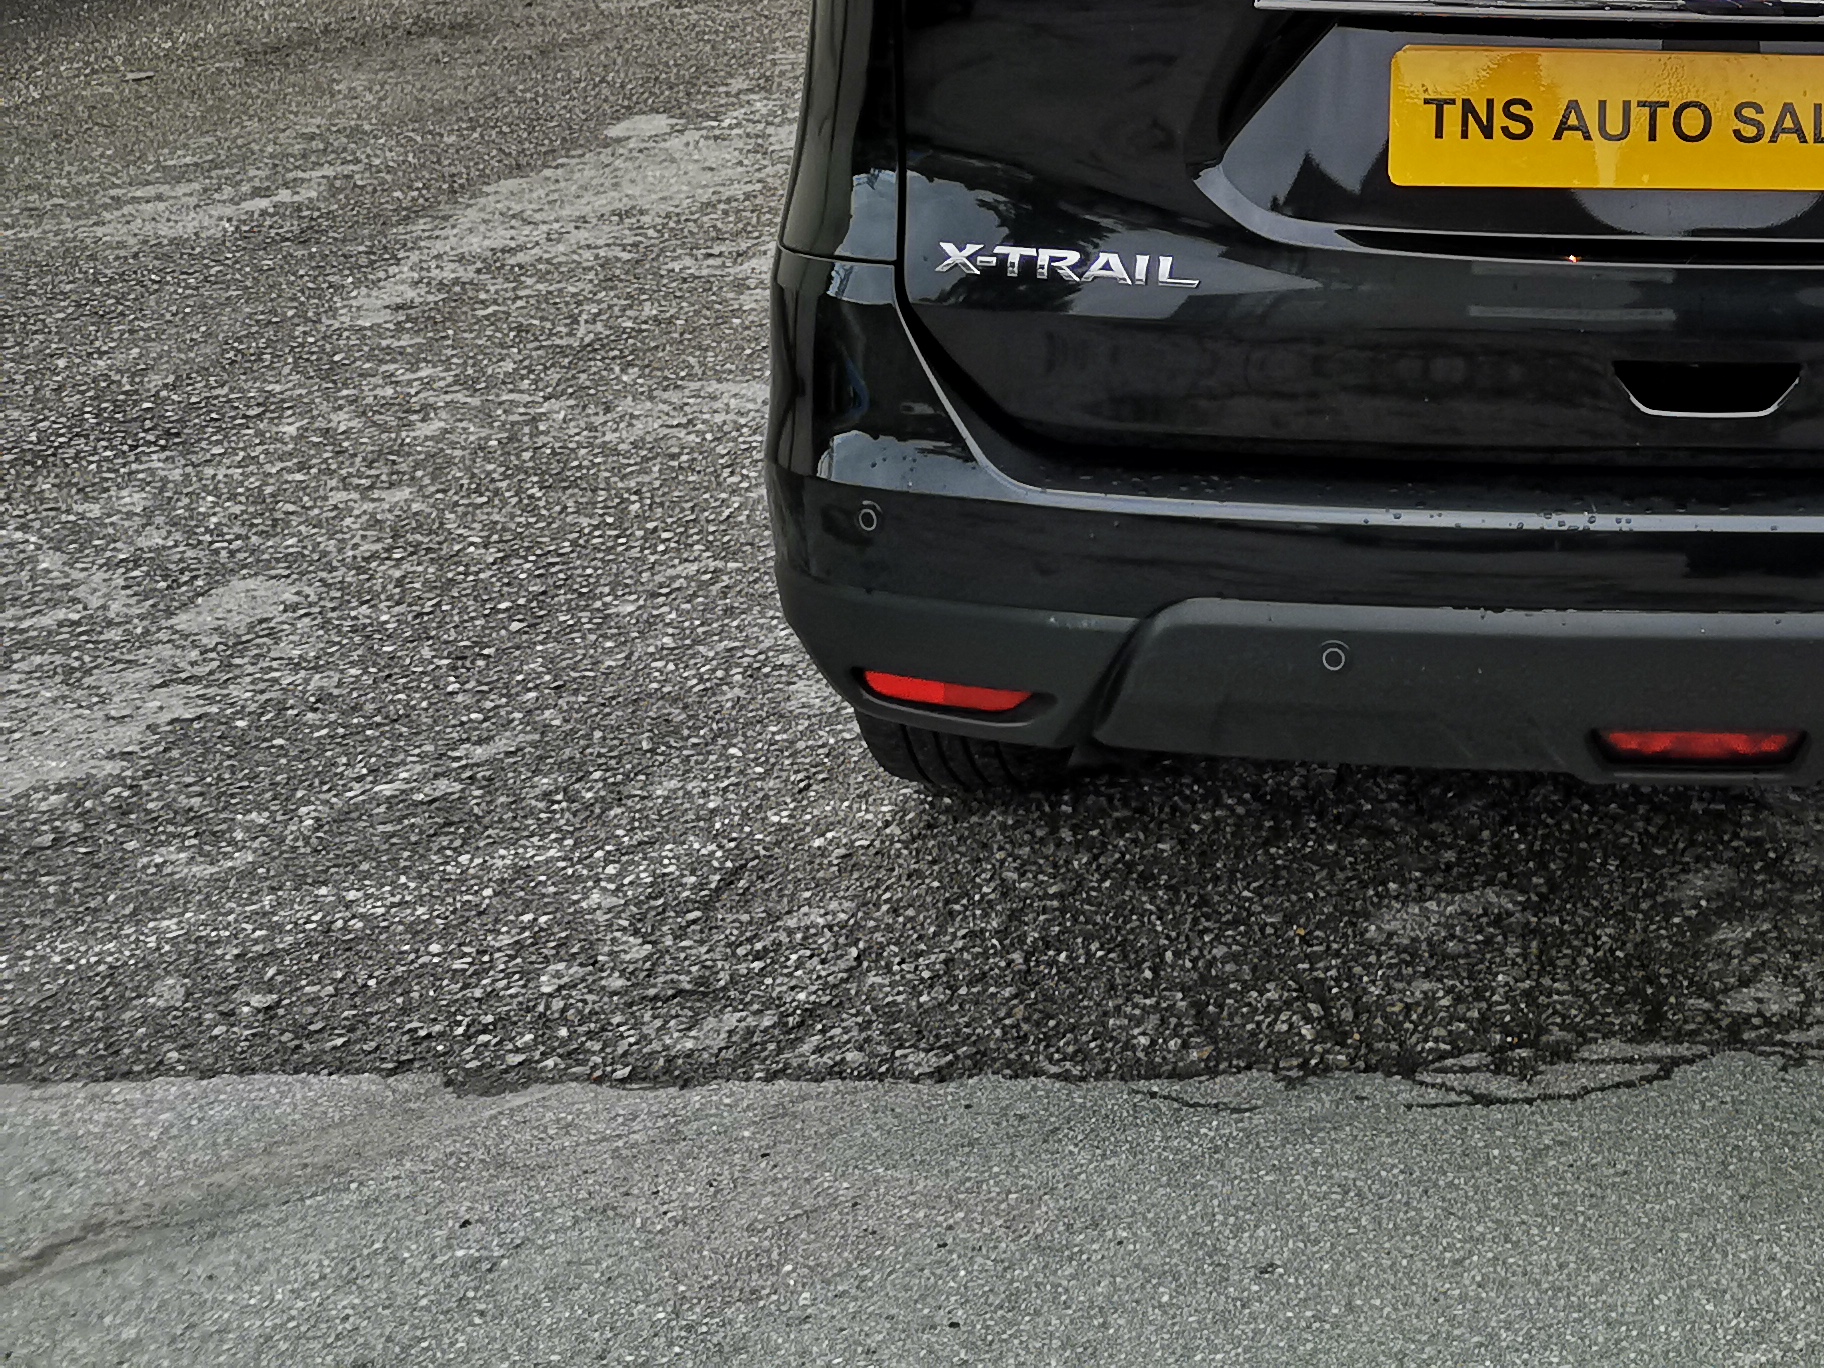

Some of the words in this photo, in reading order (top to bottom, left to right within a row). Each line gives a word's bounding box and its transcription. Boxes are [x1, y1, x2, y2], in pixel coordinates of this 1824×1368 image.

[1423, 96, 1536, 141] TNS
[1552, 98, 1714, 145] AUTO
[934, 241, 1202, 289] X-TRAIL
